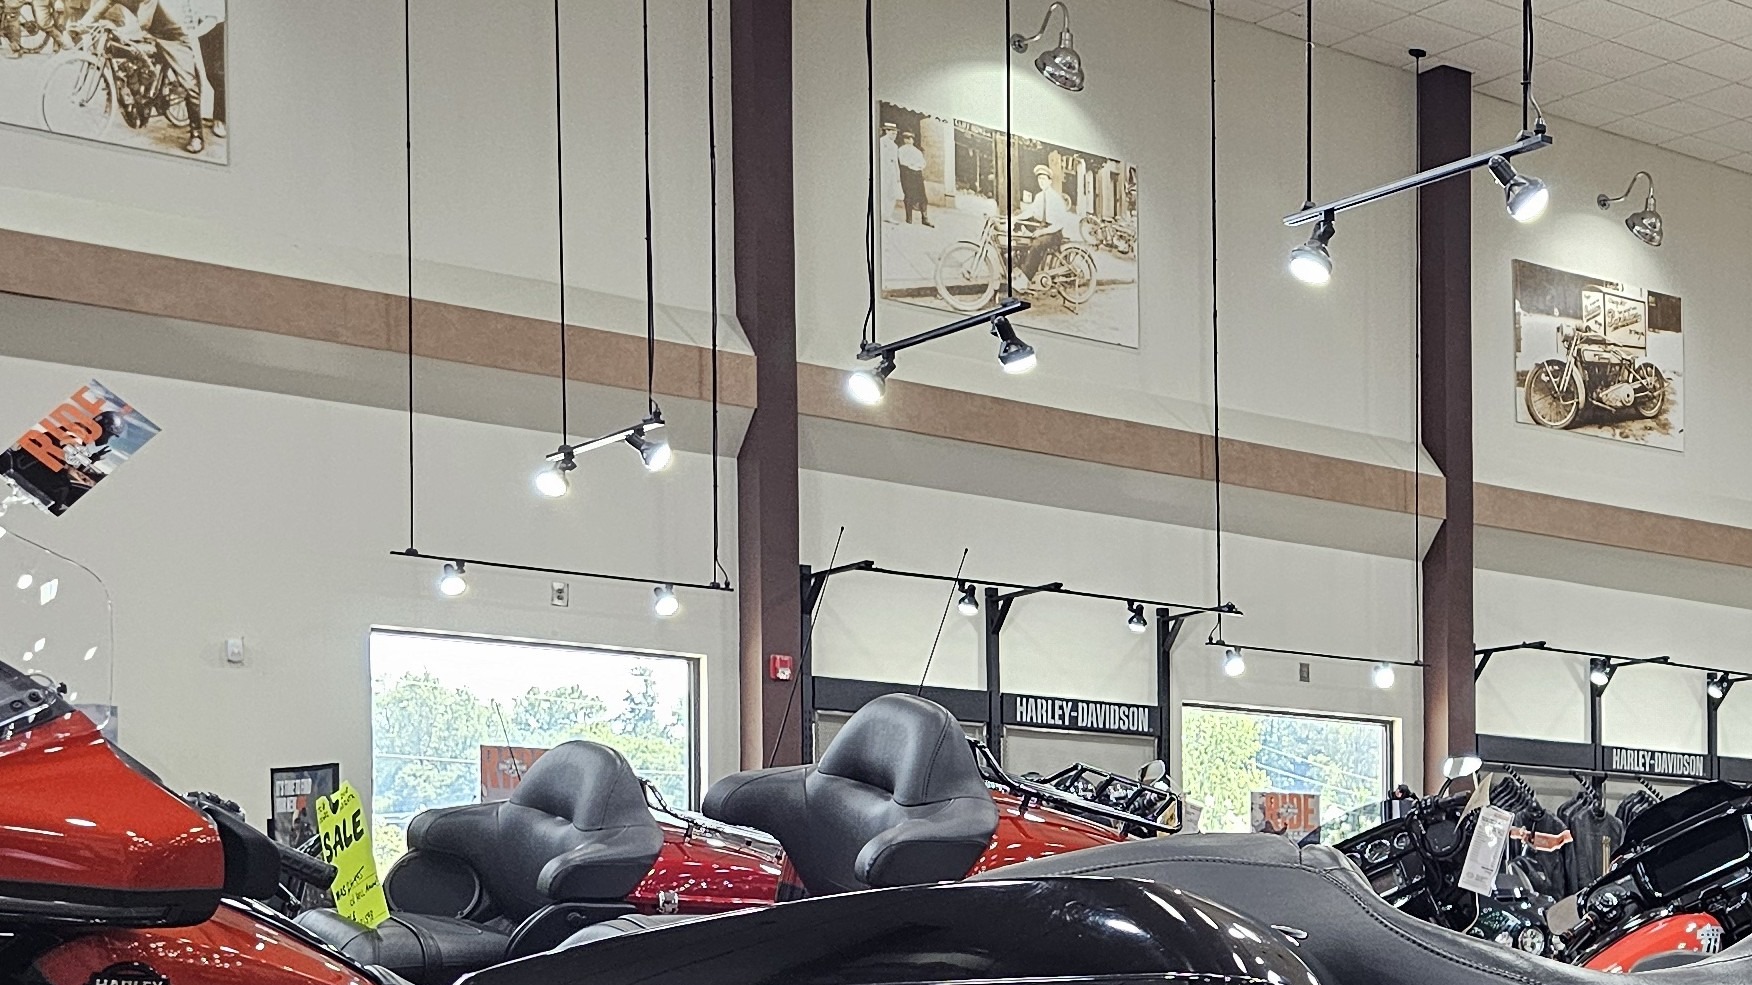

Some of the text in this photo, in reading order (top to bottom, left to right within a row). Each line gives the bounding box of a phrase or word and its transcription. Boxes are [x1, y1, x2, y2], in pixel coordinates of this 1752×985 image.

[19, 385, 106, 473] RIDE
[1016, 697, 1149, 732] HARLEY-DAVIDSON
[1612, 748, 1704, 777] HARLEY-DAVIDSON
[1264, 792, 1316, 833] RIDE
[323, 808, 365, 864] SALE
